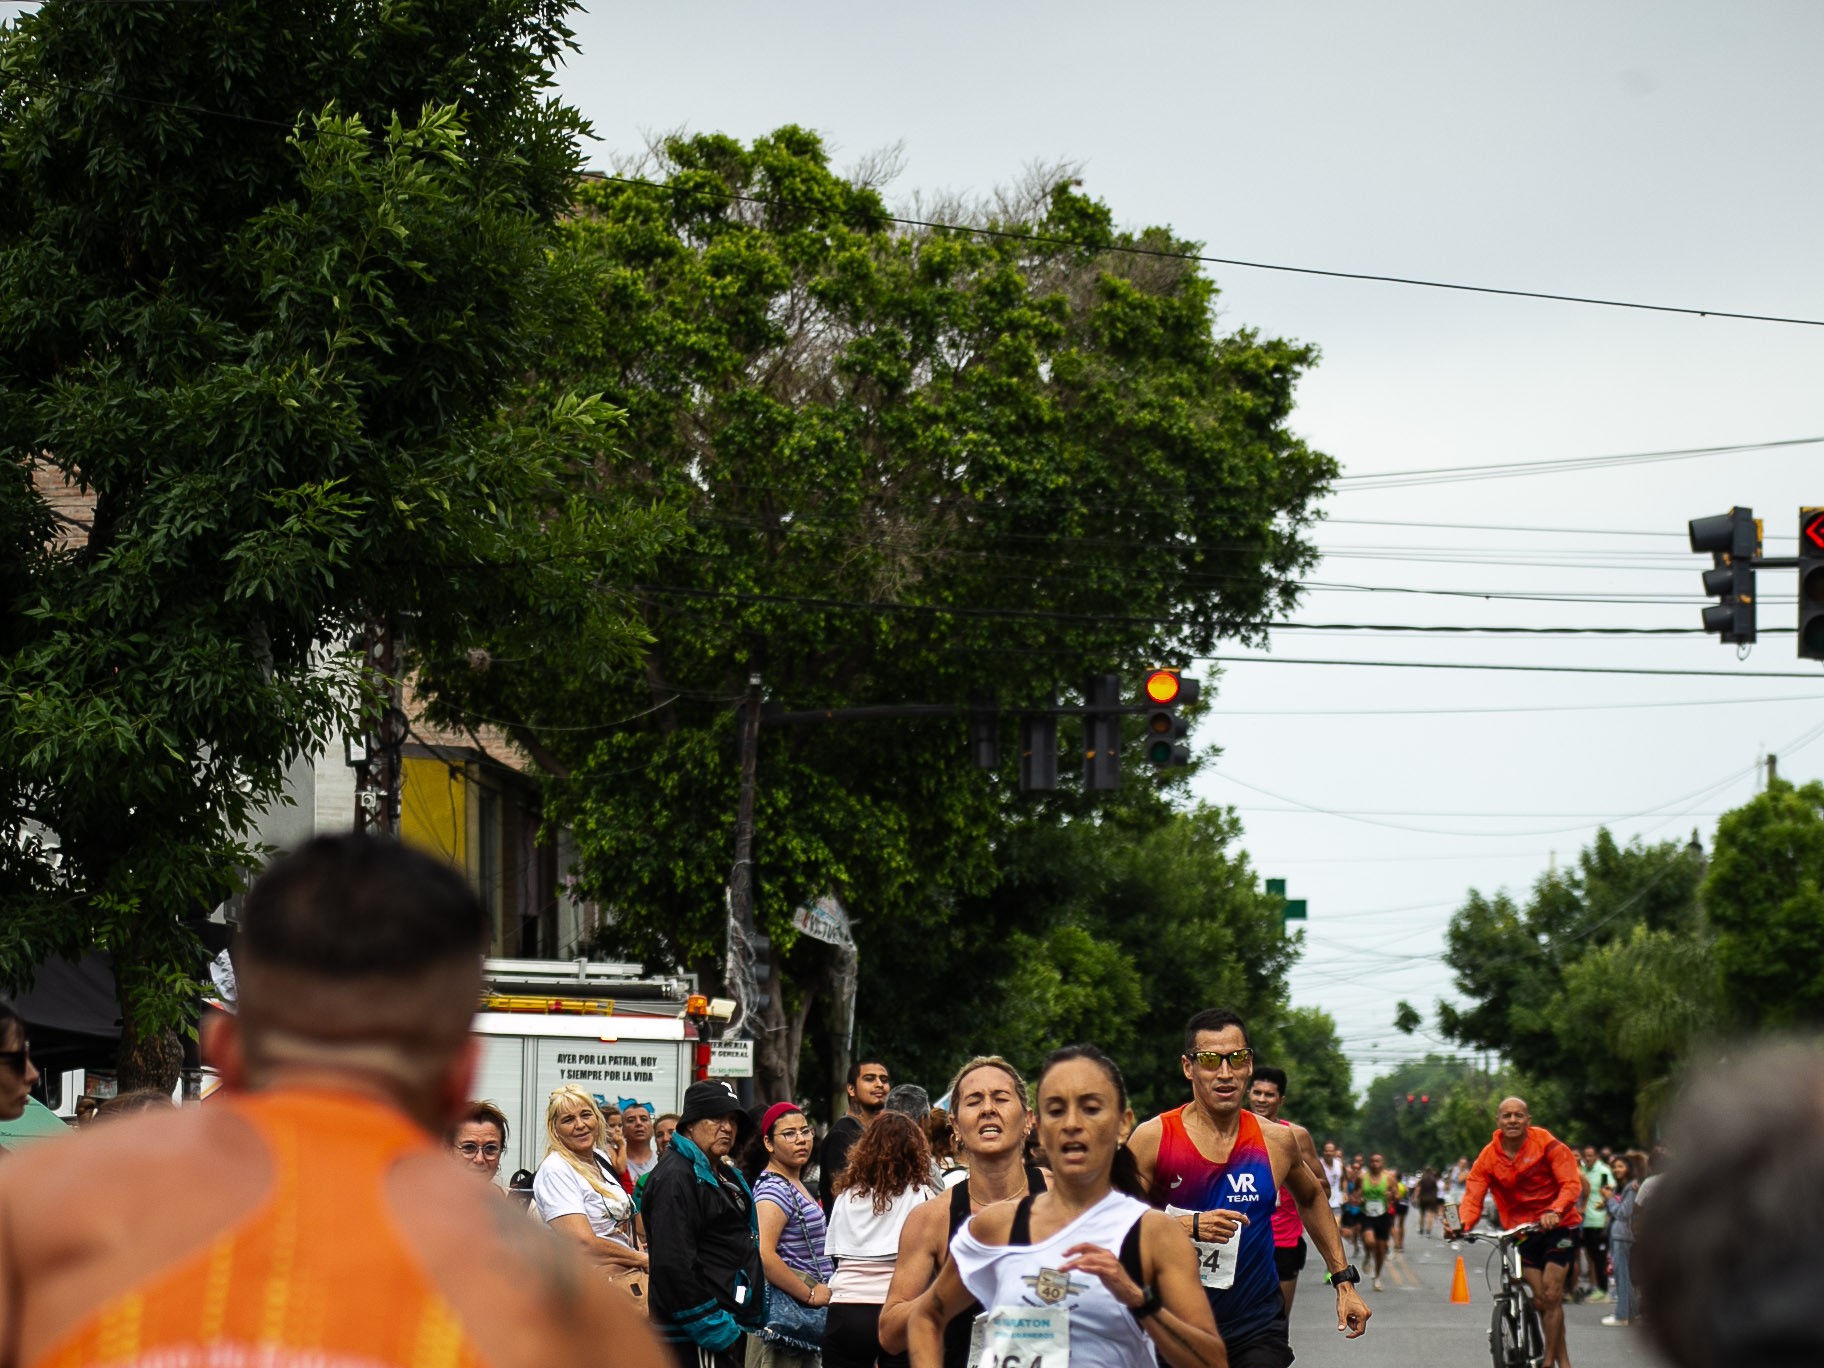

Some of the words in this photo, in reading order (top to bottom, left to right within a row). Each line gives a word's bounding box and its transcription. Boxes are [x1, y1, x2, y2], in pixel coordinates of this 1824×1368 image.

[557, 1053, 577, 1064] AYER
[579, 1054, 596, 1065] POR
[597, 1055, 607, 1066] LA
[608, 1056, 639, 1067] PATRIA,
[640, 1056, 658, 1067] HOY
[560, 1069, 566, 1080] Y
[567, 1069, 602, 1081] SIEMPRE
[604, 1070, 621, 1081] POR
[622, 1071, 632, 1082] LA
[634, 1072, 654, 1083] VIDA
[1227, 1173, 1258, 1193] VR
[1227, 1194, 1260, 1203] TEAM
[1042, 1287, 1061, 1299] 40
